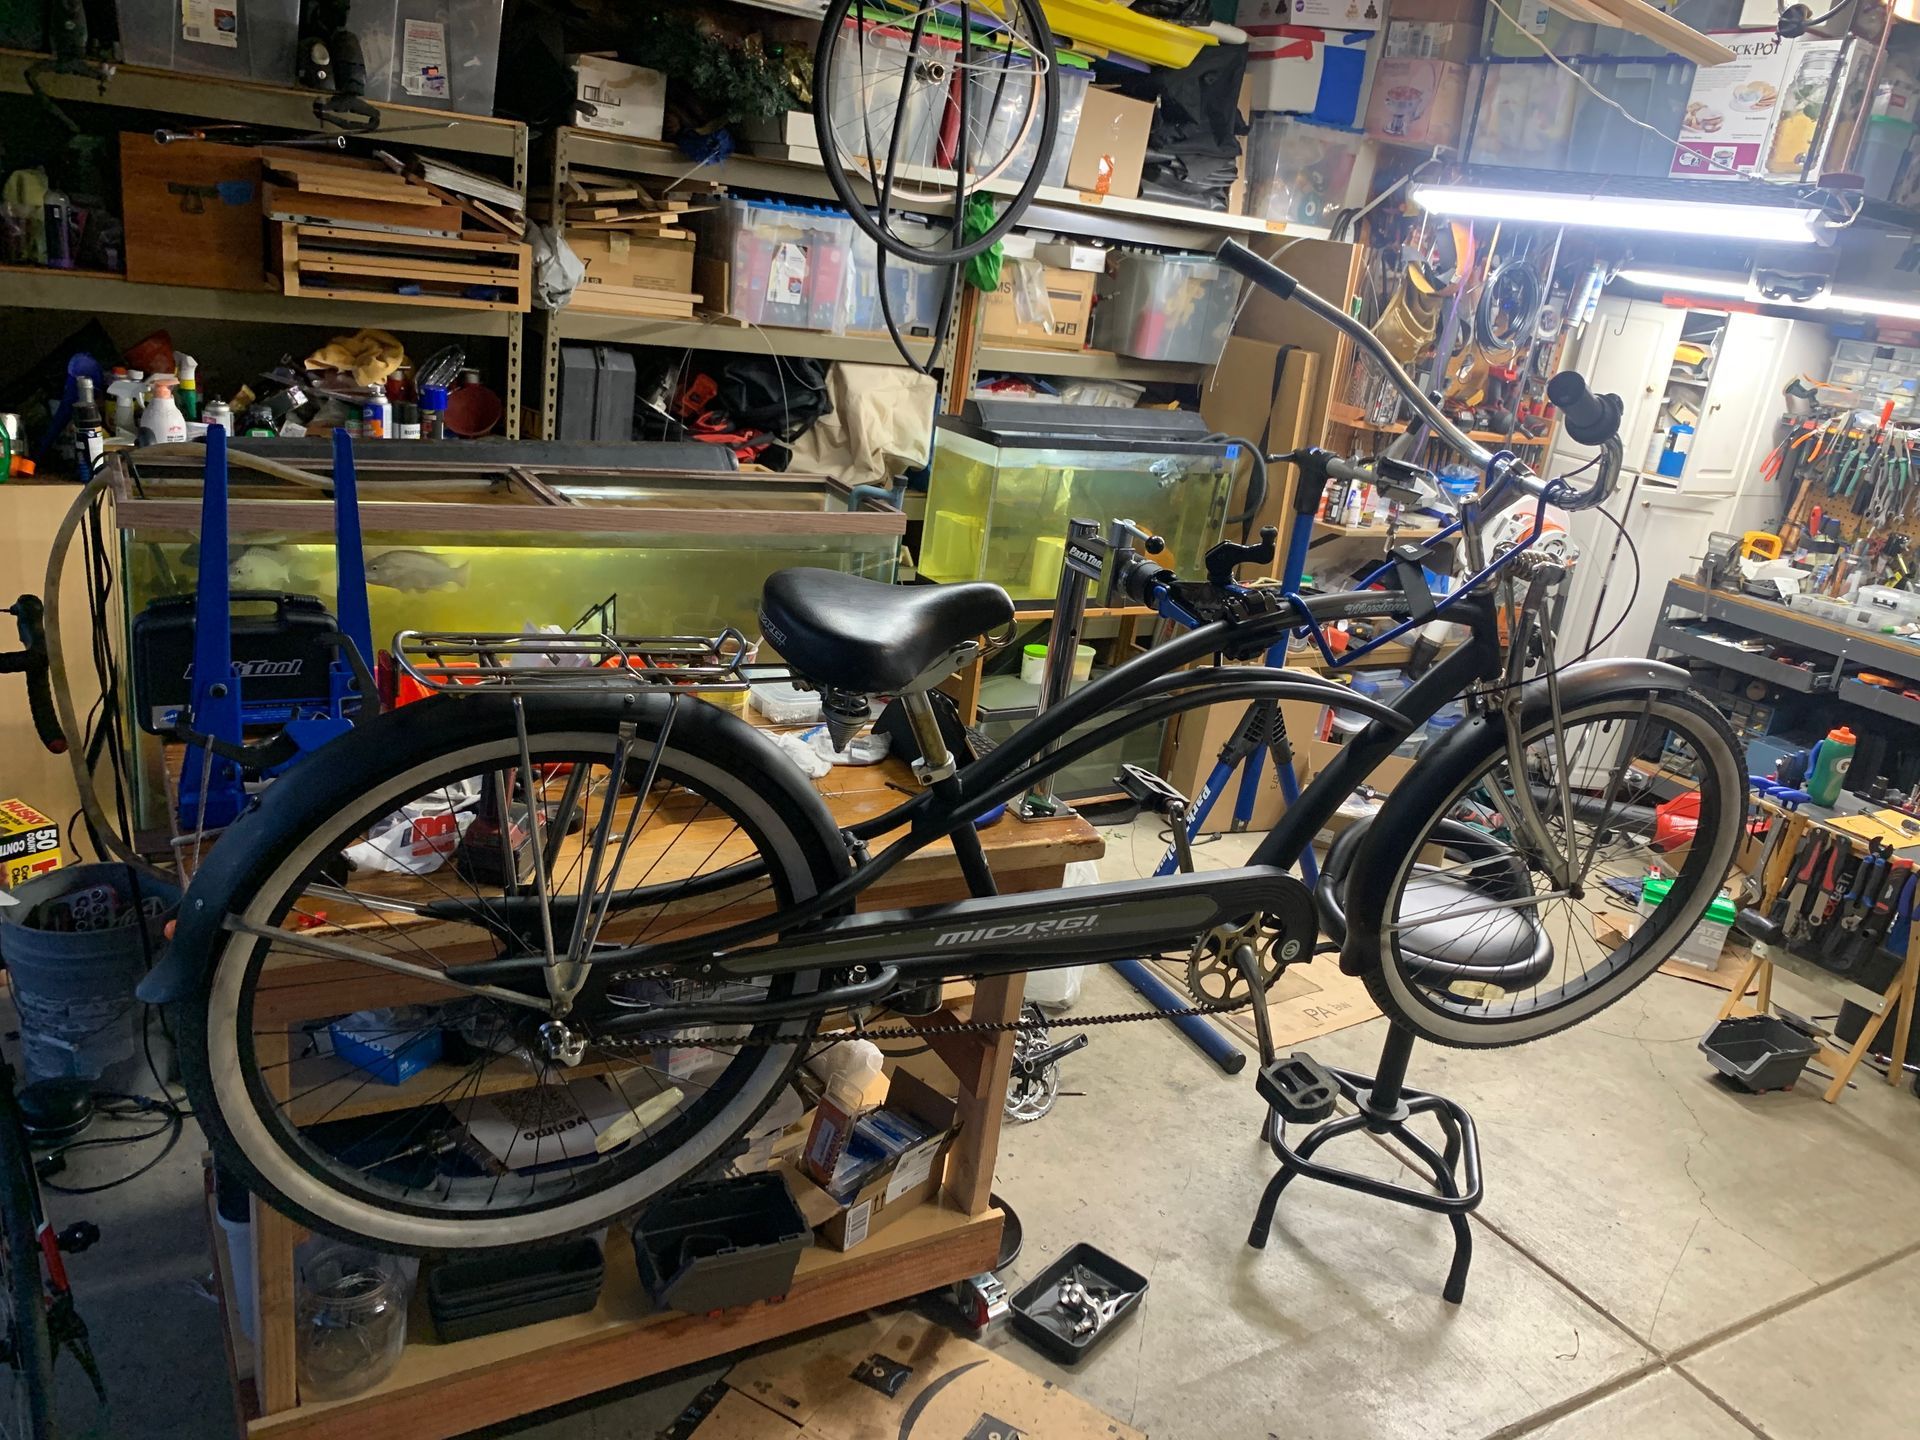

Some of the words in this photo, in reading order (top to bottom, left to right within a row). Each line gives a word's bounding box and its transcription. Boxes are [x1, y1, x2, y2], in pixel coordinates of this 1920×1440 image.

[1069, 545, 1088, 562] Park
[26, 832, 37, 853] COUNT
[35, 829, 58, 850] 50
[934, 914, 1099, 947] MICARGI
[523, 1115, 588, 1141] venmo
